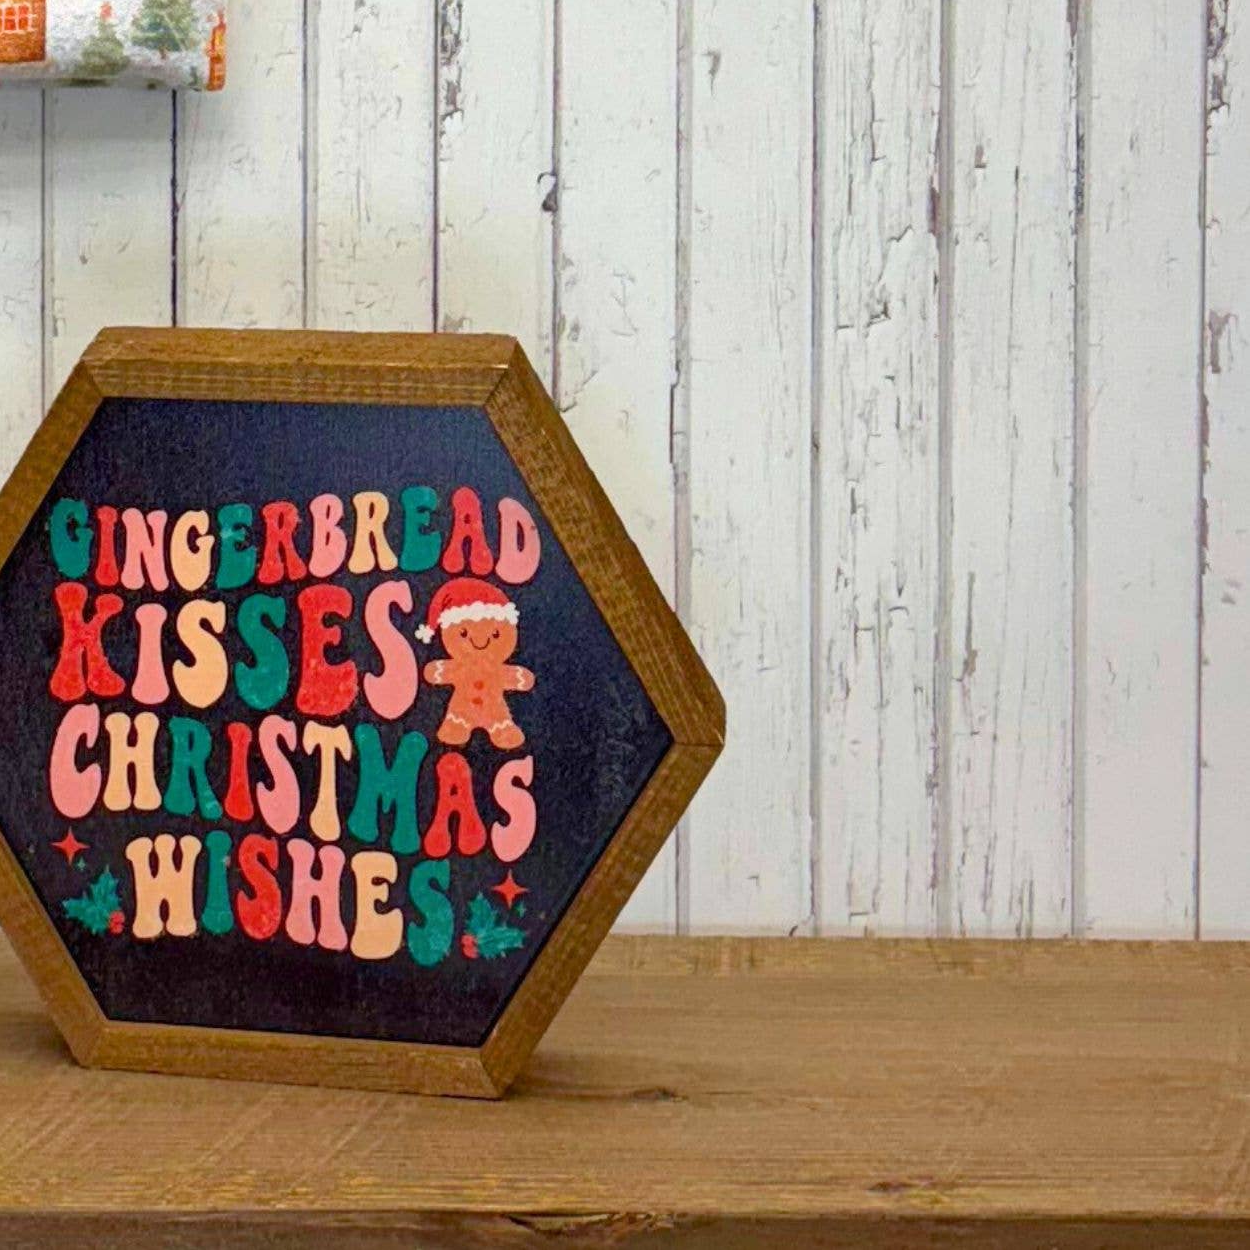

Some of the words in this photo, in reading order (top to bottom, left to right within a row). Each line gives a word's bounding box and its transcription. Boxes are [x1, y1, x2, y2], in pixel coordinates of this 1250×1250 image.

[50, 485, 541, 591] GINGERBREAD
[50, 579, 419, 720] KISSES
[50, 703, 537, 862] CHRISTMAS
[125, 830, 453, 967] WISHES
